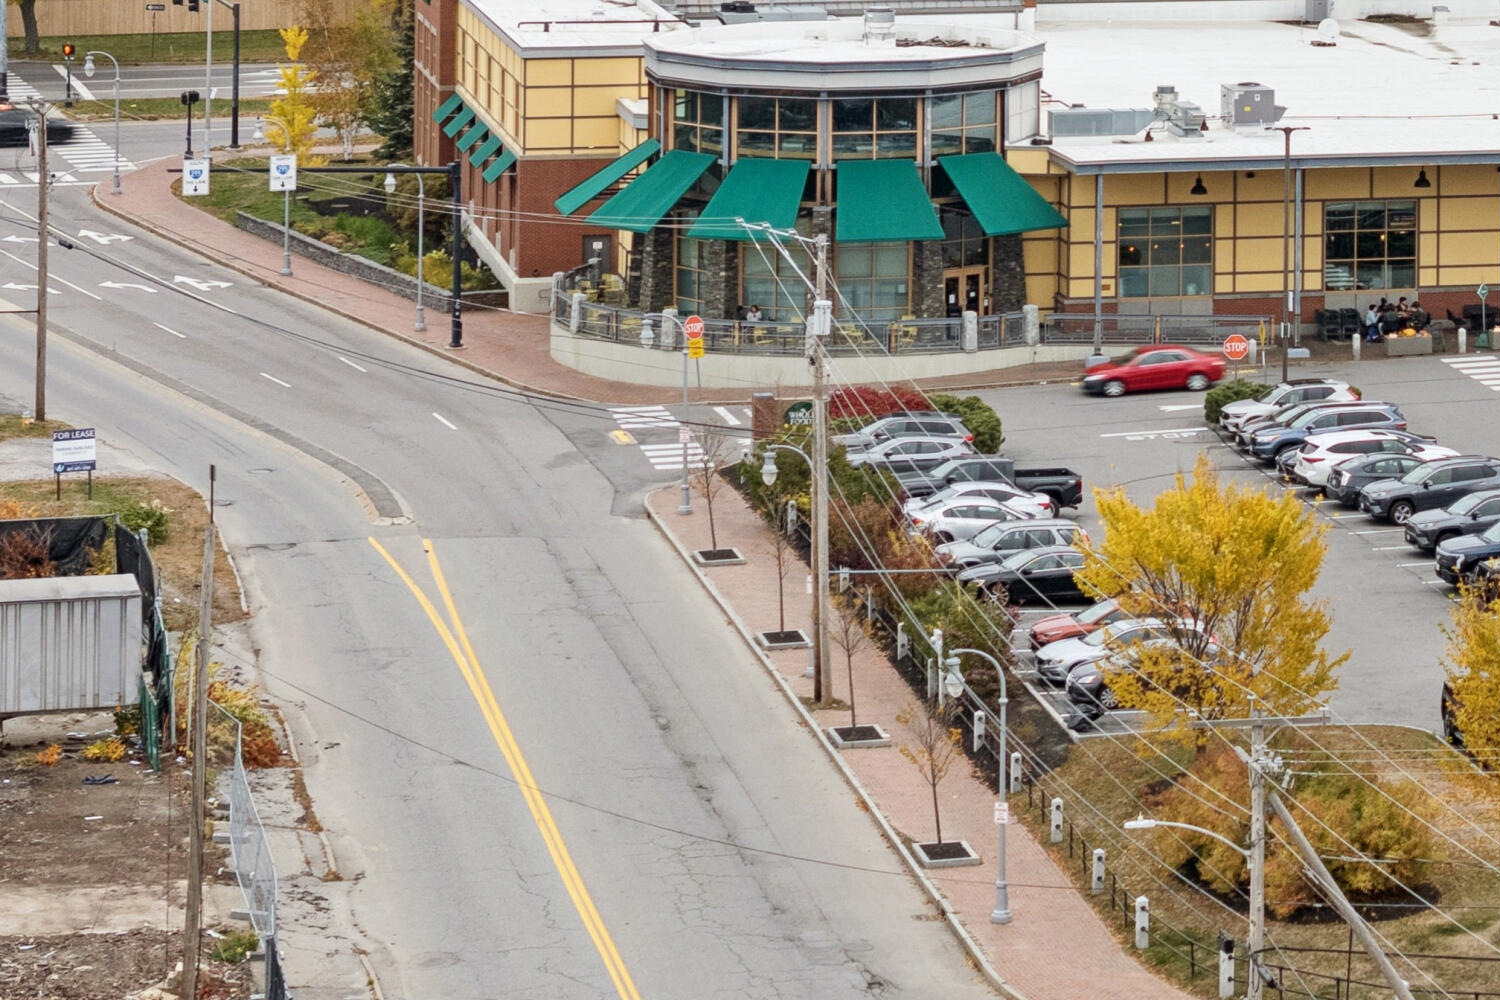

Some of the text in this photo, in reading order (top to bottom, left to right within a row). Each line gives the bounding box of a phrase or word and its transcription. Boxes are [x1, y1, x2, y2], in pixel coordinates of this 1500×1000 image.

[686, 322, 704, 333] STOP
[1225, 342, 1247, 352] STOP
[53, 430, 94, 441] FOR LEASE
[1125, 432, 1197, 441] STOP
